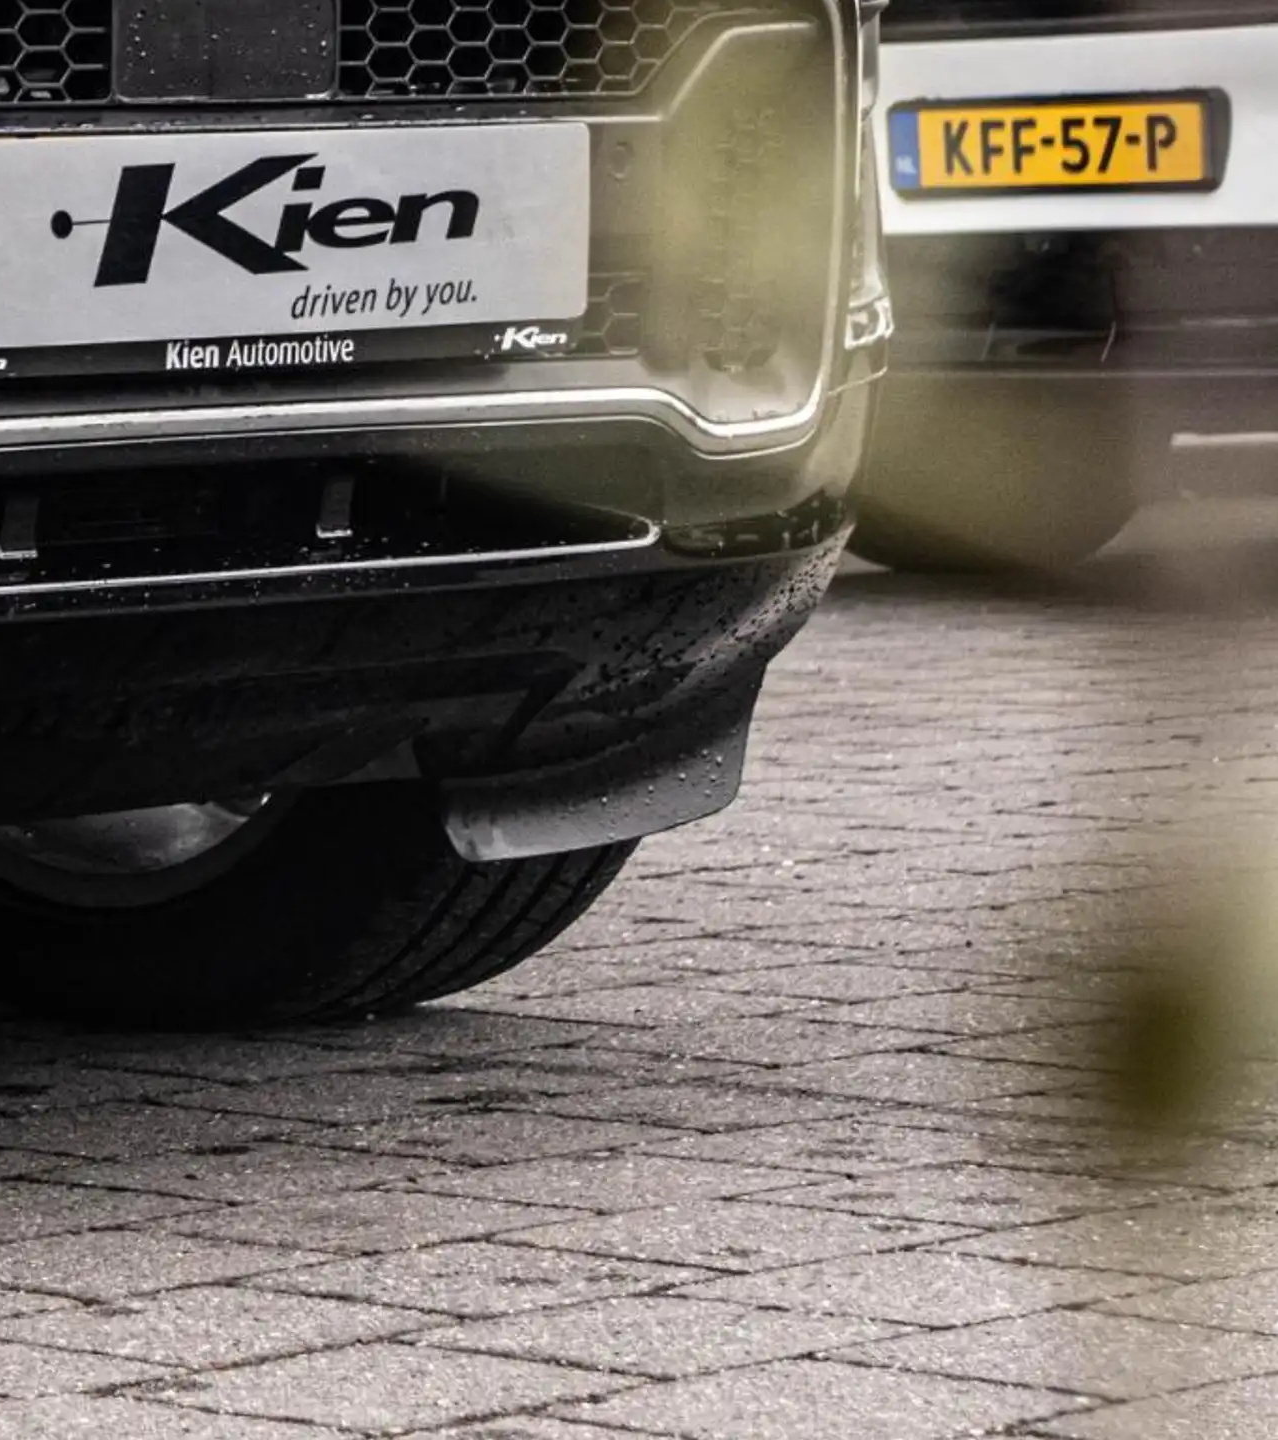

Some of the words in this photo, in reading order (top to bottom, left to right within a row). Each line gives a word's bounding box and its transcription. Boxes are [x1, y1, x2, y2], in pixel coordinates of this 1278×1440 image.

[943, 114, 1178, 176] KFF-57-P
[94, 153, 480, 288] Kien
[291, 284, 378, 320] driven
[385, 278, 418, 317] by
[422, 278, 479, 316] you.
[165, 339, 220, 370] Kien
[225, 333, 355, 369] Automotive
